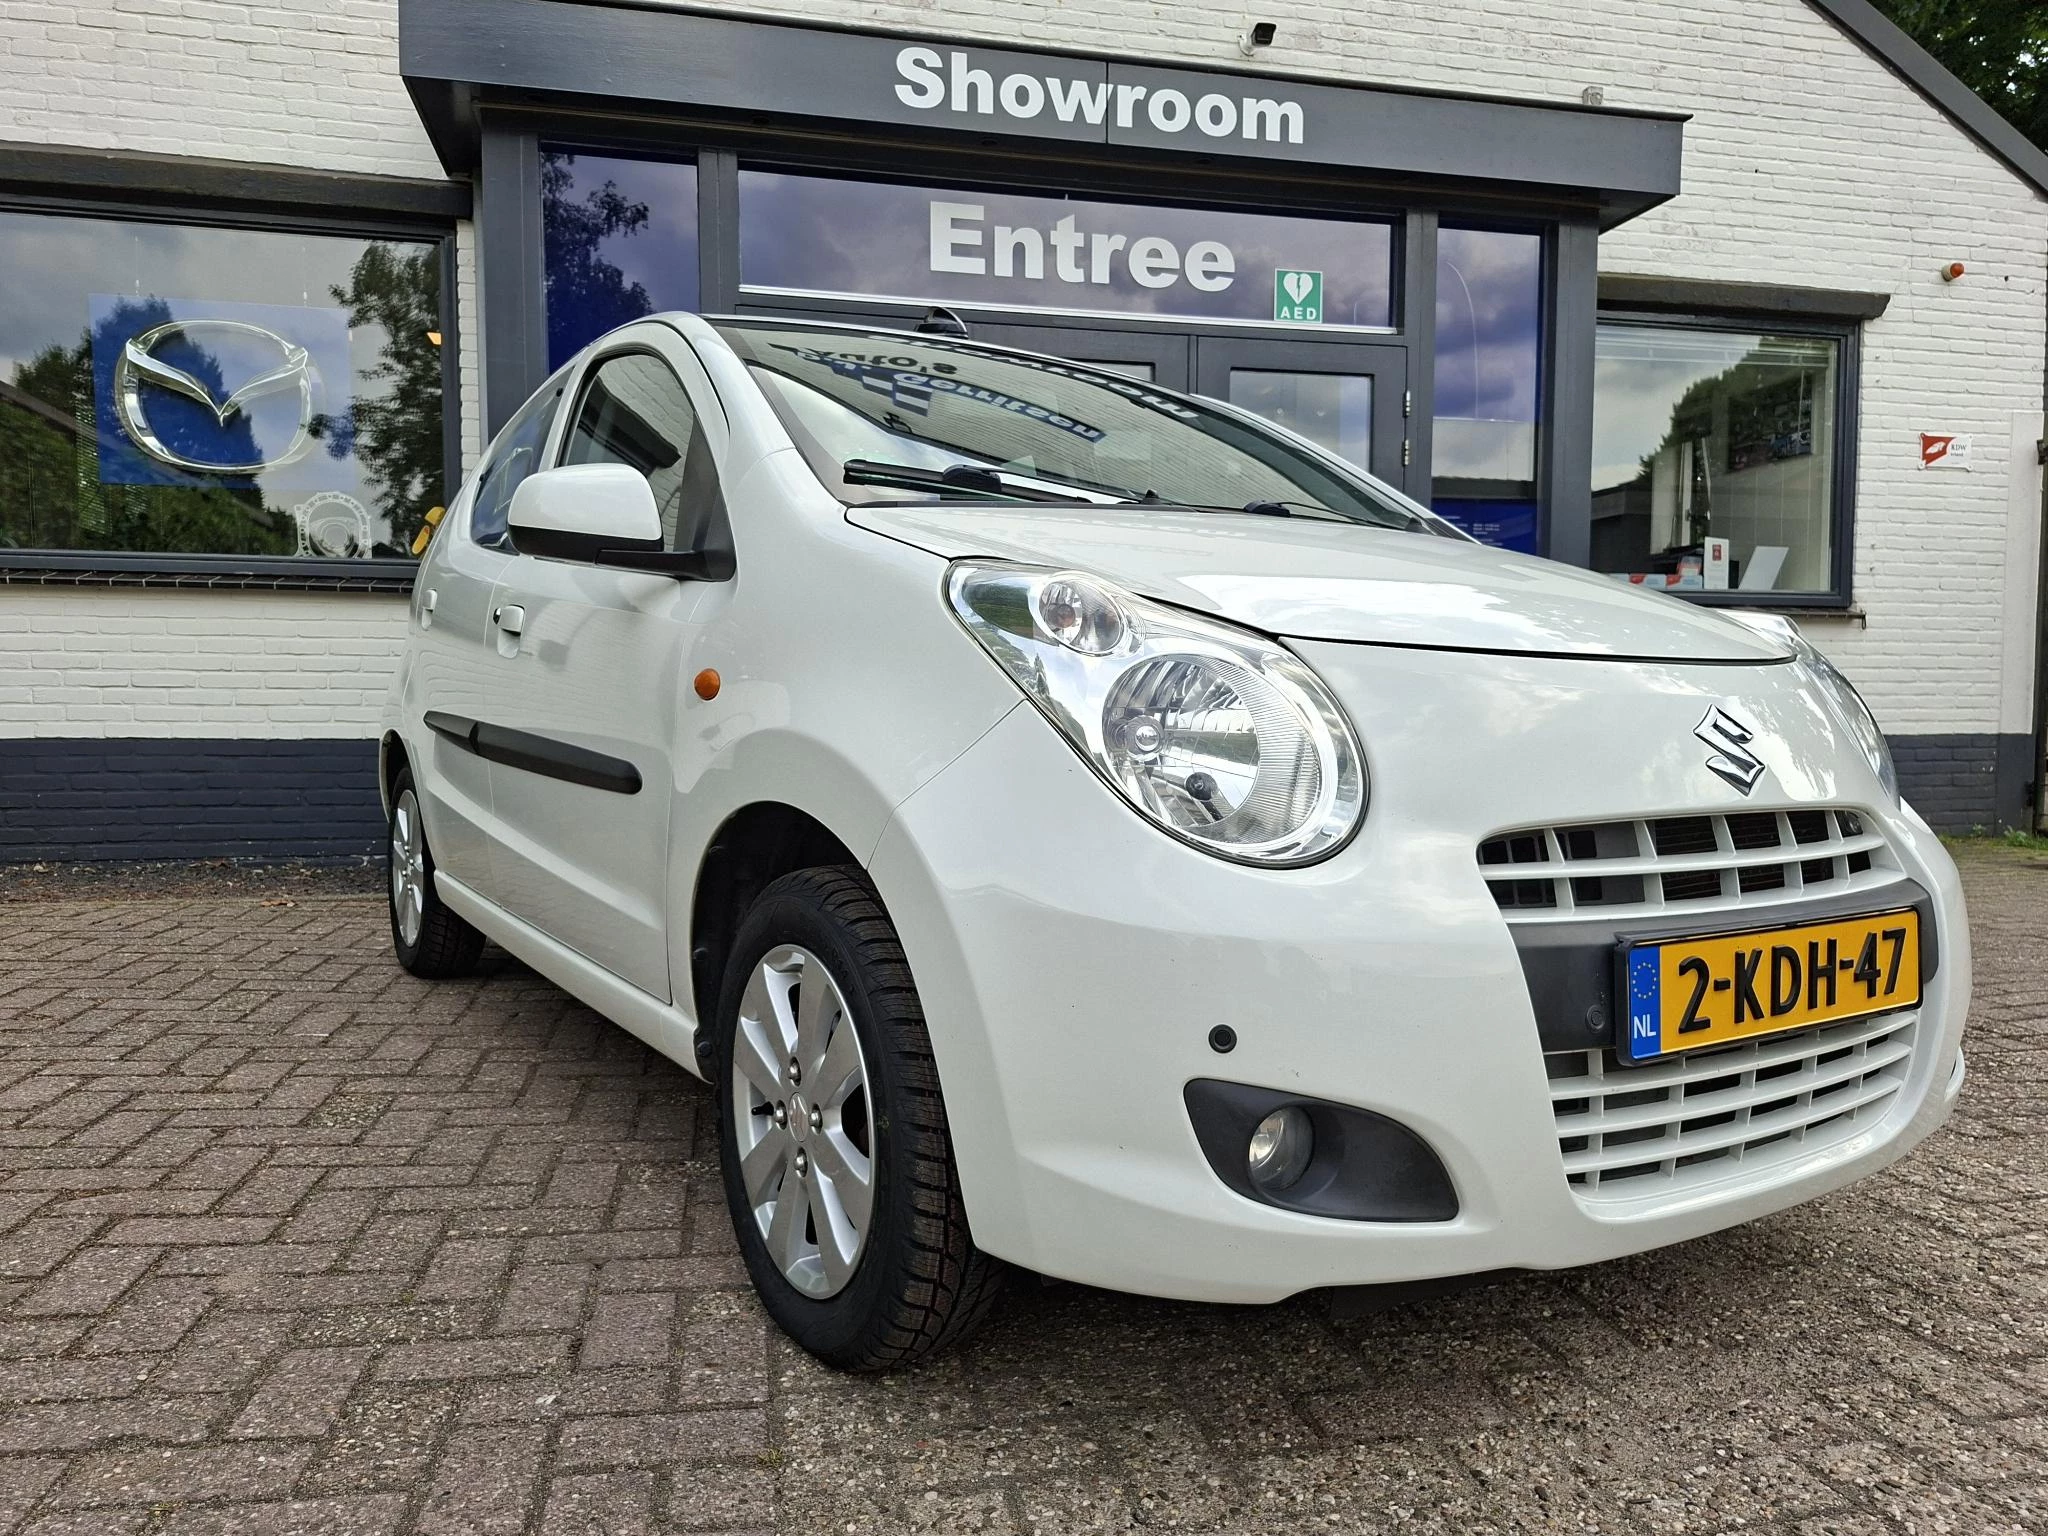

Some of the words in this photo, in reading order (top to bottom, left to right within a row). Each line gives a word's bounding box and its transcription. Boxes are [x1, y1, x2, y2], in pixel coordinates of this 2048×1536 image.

[894, 46, 1304, 144] Showroom
[930, 201, 1236, 292] Entree
[1280, 306, 1317, 320] AED
[1633, 1014, 1657, 1039] NL
[1678, 927, 1907, 1034] 2-KDH-47
